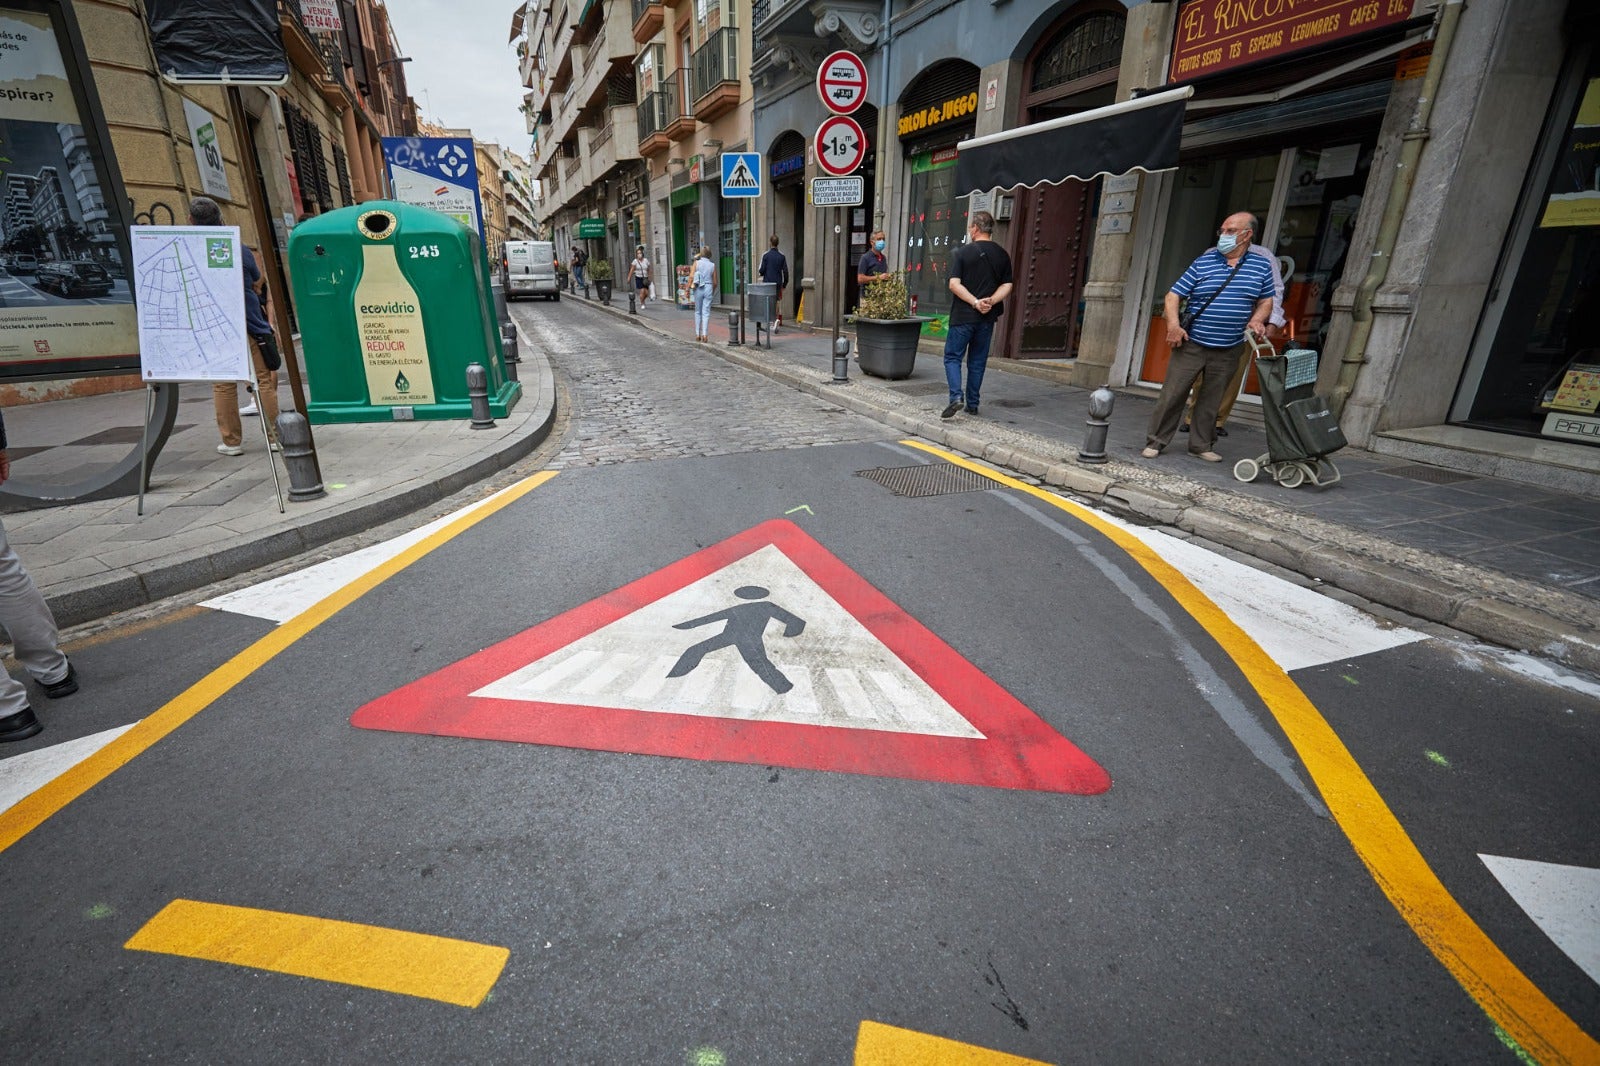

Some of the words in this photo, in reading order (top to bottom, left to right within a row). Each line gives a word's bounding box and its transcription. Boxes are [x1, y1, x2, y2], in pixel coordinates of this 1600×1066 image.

[307, 6, 333, 16] VENDE
[15, 33, 28, 42] de
[1178, 54, 1201, 74] FRUTOS
[1201, 47, 1223, 67] SECOS
[1229, 40, 1242, 59] TÉS
[1248, 30, 1283, 54] ESPECIAS
[1290, 13, 1341, 43] LEGUMBRES
[927, 106, 941, 126] de
[941, 92, 978, 122] JUEGO
[370, 228, 393, 239] VIDRIO
[409, 245, 440, 259] 245
[360, 301, 415, 314] ecovidrio
[366, 341, 406, 352] REDUCIR
